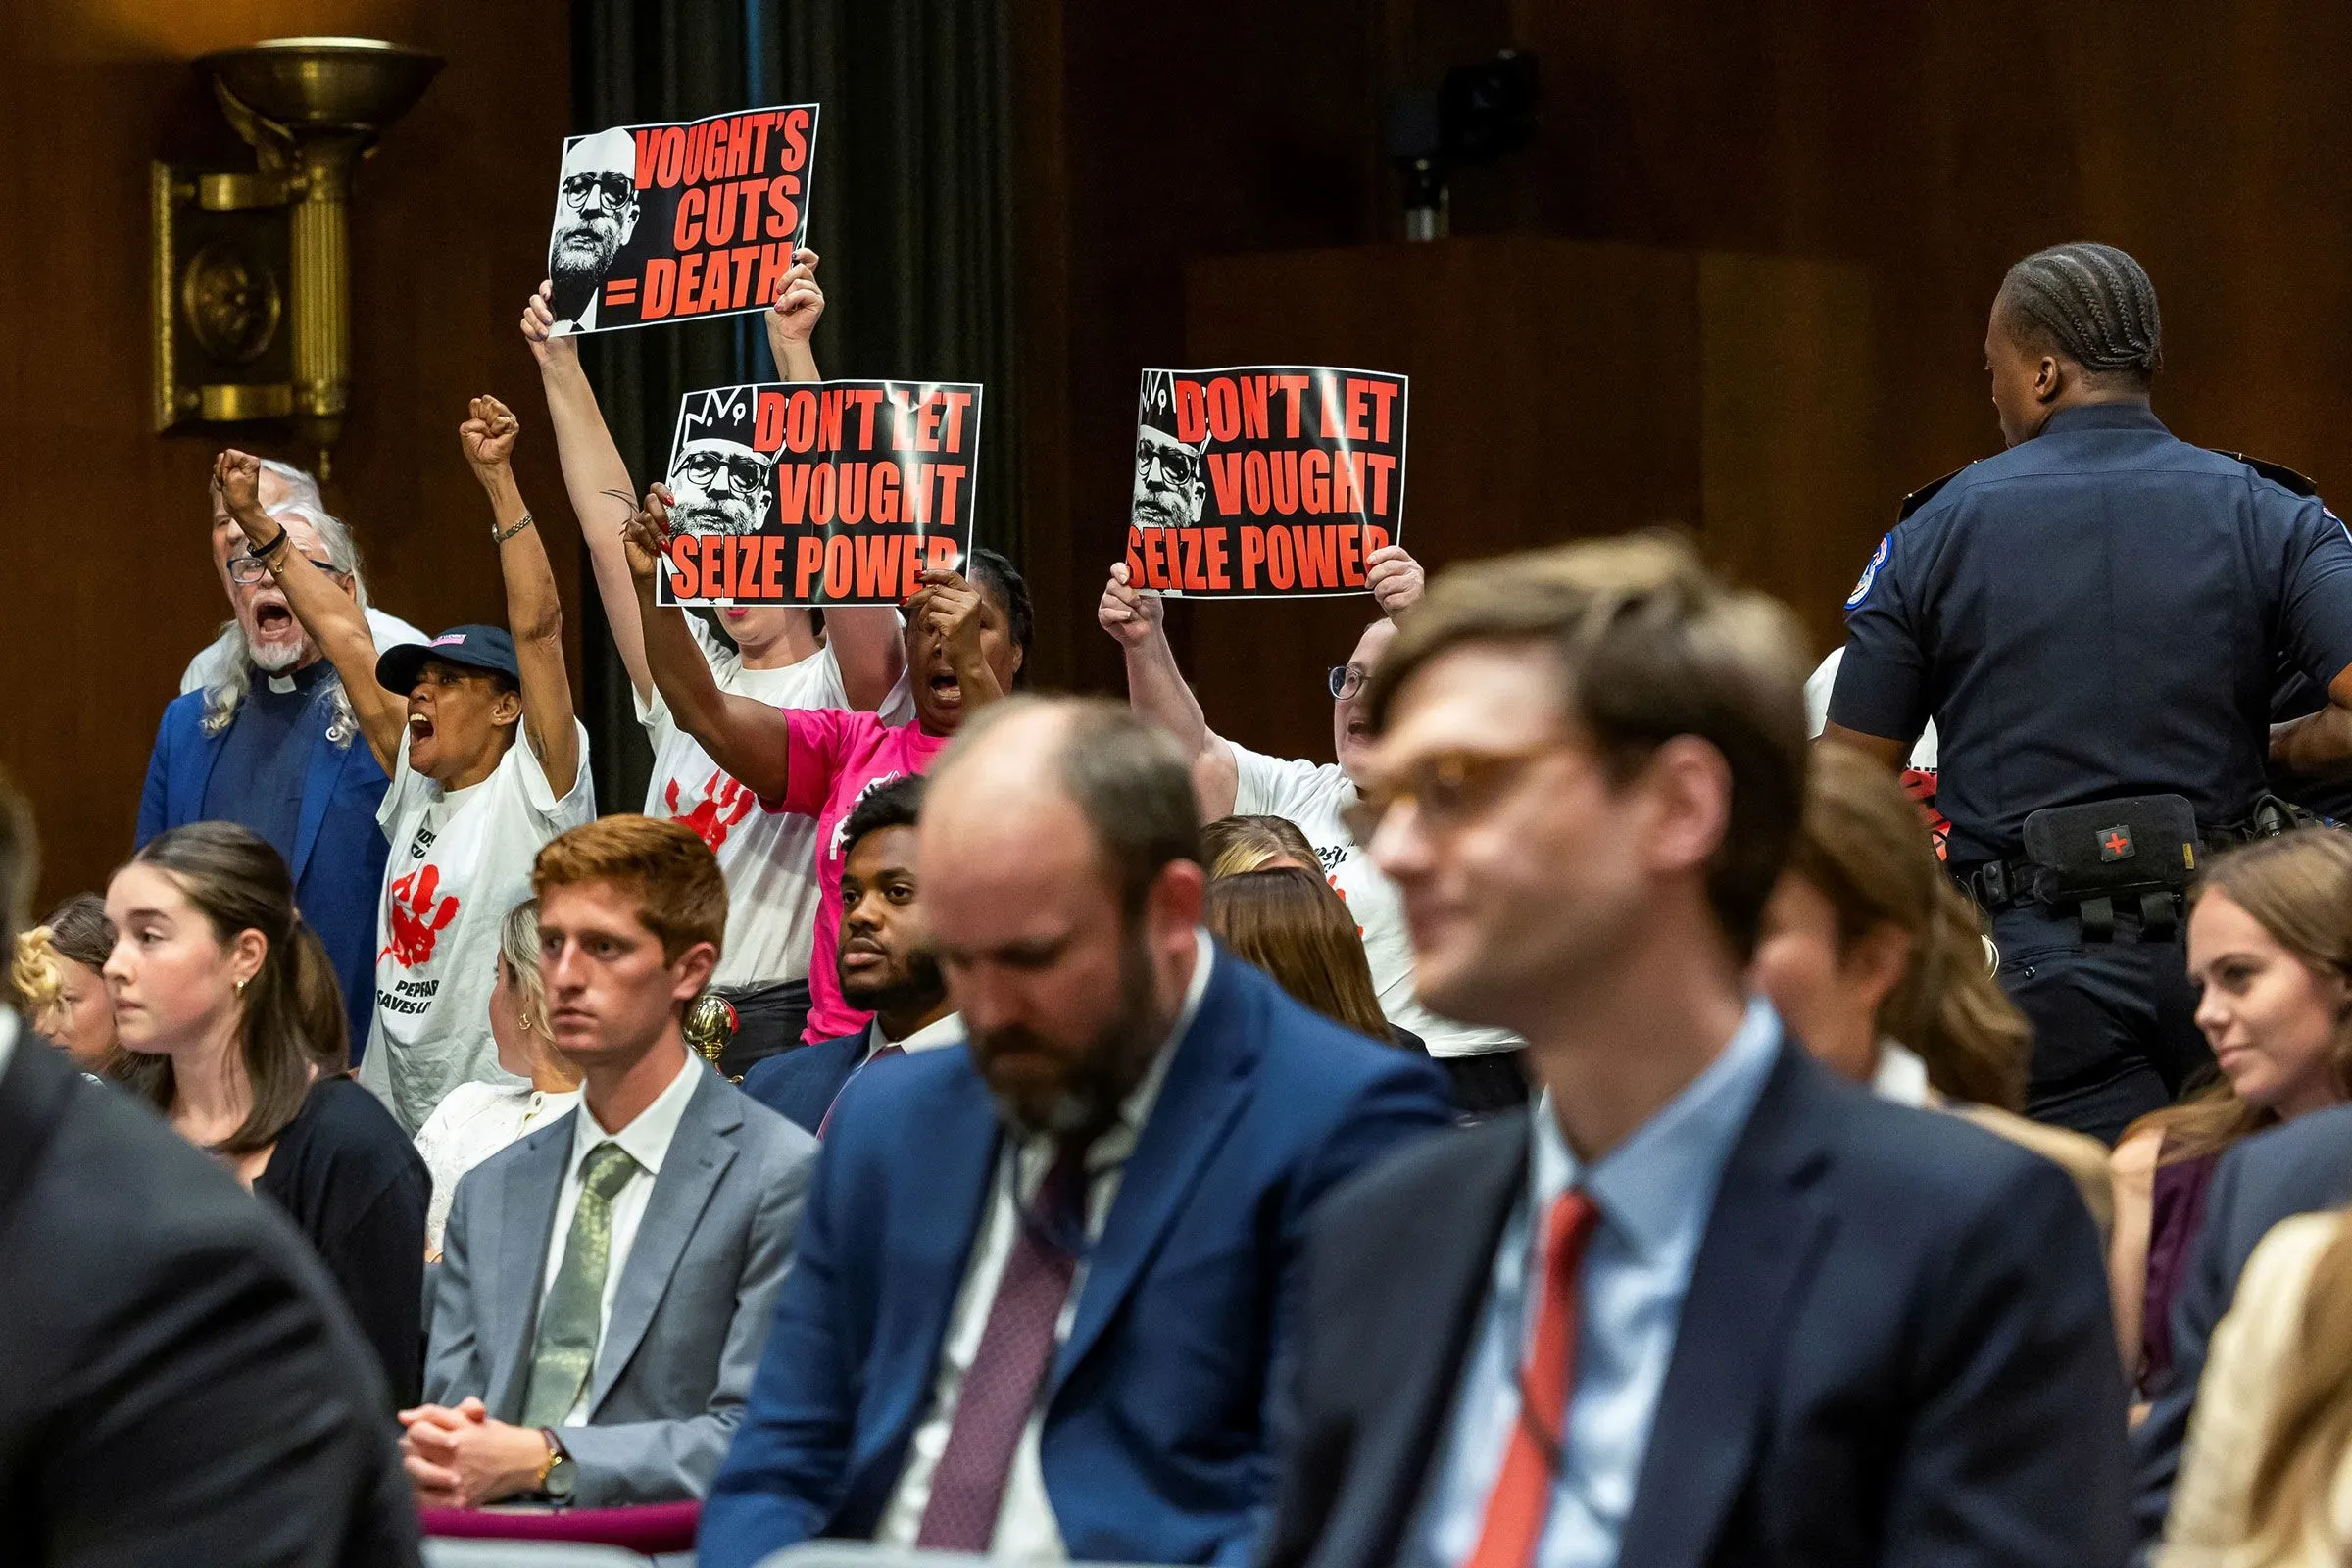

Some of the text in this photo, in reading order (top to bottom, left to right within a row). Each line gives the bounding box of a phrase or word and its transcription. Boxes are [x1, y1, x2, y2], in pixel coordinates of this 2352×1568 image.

[635, 109, 809, 190] VOUGHT'S
[673, 175, 801, 251] CUTS
[641, 241, 794, 319] DEATH
[753, 389, 971, 454] DON'T LET
[1175, 375, 1398, 443] DON'T LET
[779, 461, 966, 526] VOUGHT
[1206, 448, 1396, 515] VOUGHT
[671, 534, 785, 599] SEIZE
[1126, 525, 1231, 590] SEIZE
